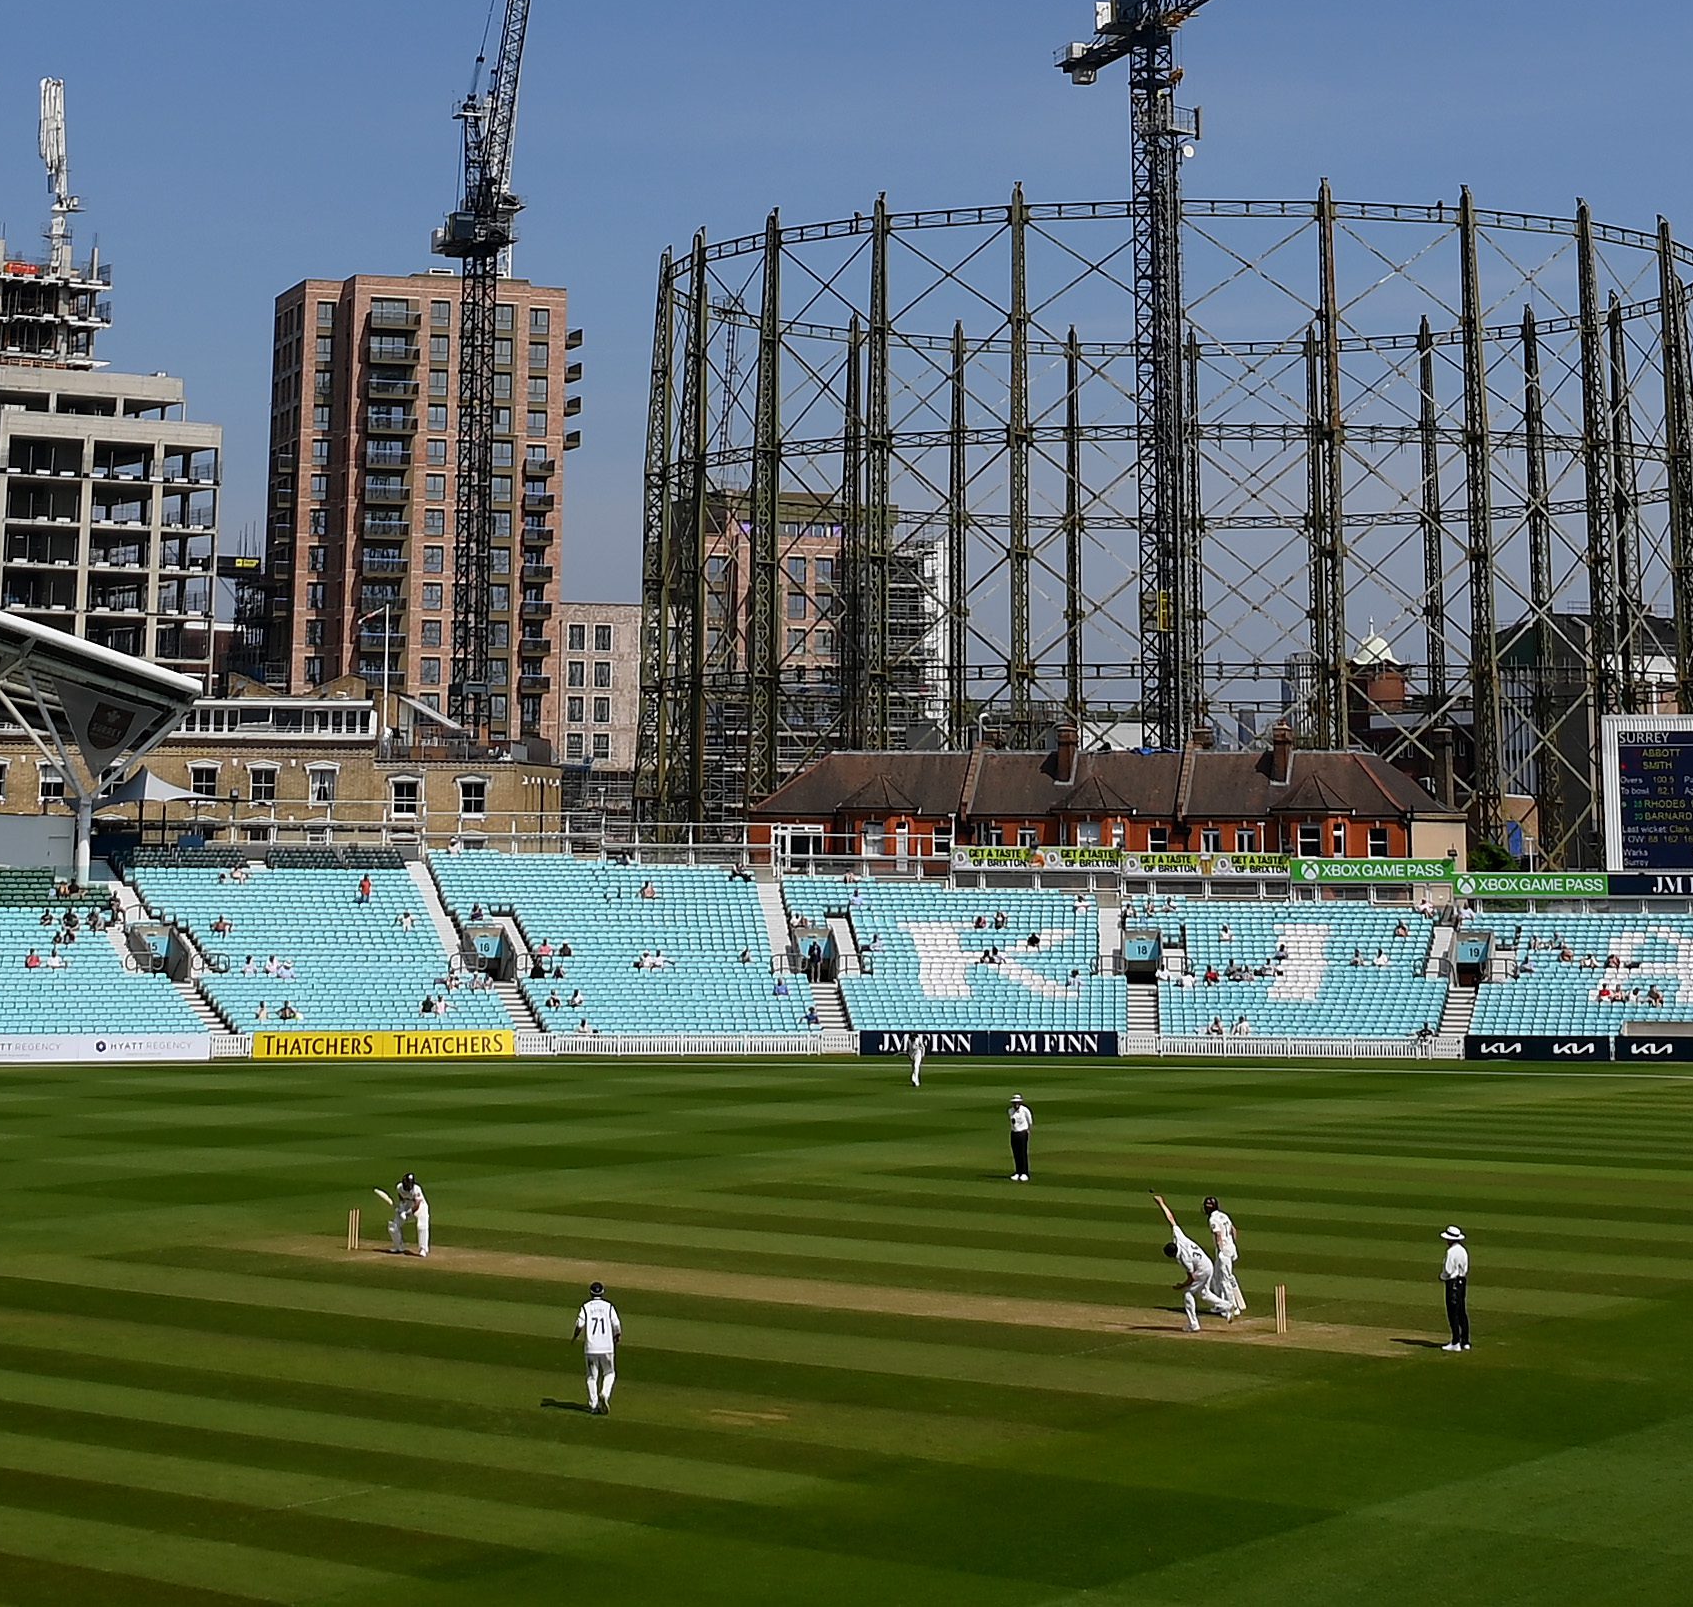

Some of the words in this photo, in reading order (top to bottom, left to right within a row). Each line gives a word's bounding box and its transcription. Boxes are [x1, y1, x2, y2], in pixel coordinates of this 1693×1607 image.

[1619, 732, 1669, 743] SURREY
[1642, 749, 1681, 757] ABBOTT
[1642, 761, 1673, 770] SMITH
[1644, 800, 1686, 808] RHODES
[1644, 812, 1693, 821] BARNARD
[968, 849, 985, 858] GET
[987, 849, 993, 858] A
[994, 849, 1022, 858] TASTE
[1061, 849, 1077, 858] GET
[1079, 849, 1086, 858] A
[1087, 849, 1114, 858] TASTE
[972, 858, 985, 867] OF
[987, 858, 1028, 868] BRIXTON
[1064, 859, 1077, 868] OF
[1079, 859, 1119, 868] BRIXTON
[1140, 855, 1156, 864] GET
[1157, 855, 1164, 864] A
[1164, 855, 1191, 864] TASTE
[1231, 855, 1247, 864] GET
[1249, 855, 1255, 864] A
[1256, 855, 1283, 864] TASTE
[1144, 865, 1157, 873] OF
[1158, 865, 1198, 873] BRIXTON
[1235, 865, 1247, 873] OF
[1250, 865, 1289, 874] BRIXTON
[1321, 864, 1360, 877] XBOX
[1364, 864, 1404, 877] GAME
[1407, 863, 1444, 877] PASS
[1478, 877, 1518, 892] XBOX
[1520, 877, 1563, 891] GAME
[1566, 878, 1604, 892] PASS
[1652, 876, 1683, 893] JM
[1137, 945, 1148, 955] 18
[1469, 947, 1480, 957] 19
[15, 1042, 62, 1051] REGENCY
[110, 1042, 143, 1050] HYATT
[146, 1041, 193, 1050] REGENCY
[263, 1034, 373, 1055] THATCHERS
[393, 1033, 503, 1054] THATCHERS
[878, 1033, 909, 1053] JM
[1006, 1034, 1037, 1053] JM
[1042, 1034, 1098, 1053] FINN
[591, 1317, 605, 1335] 71
